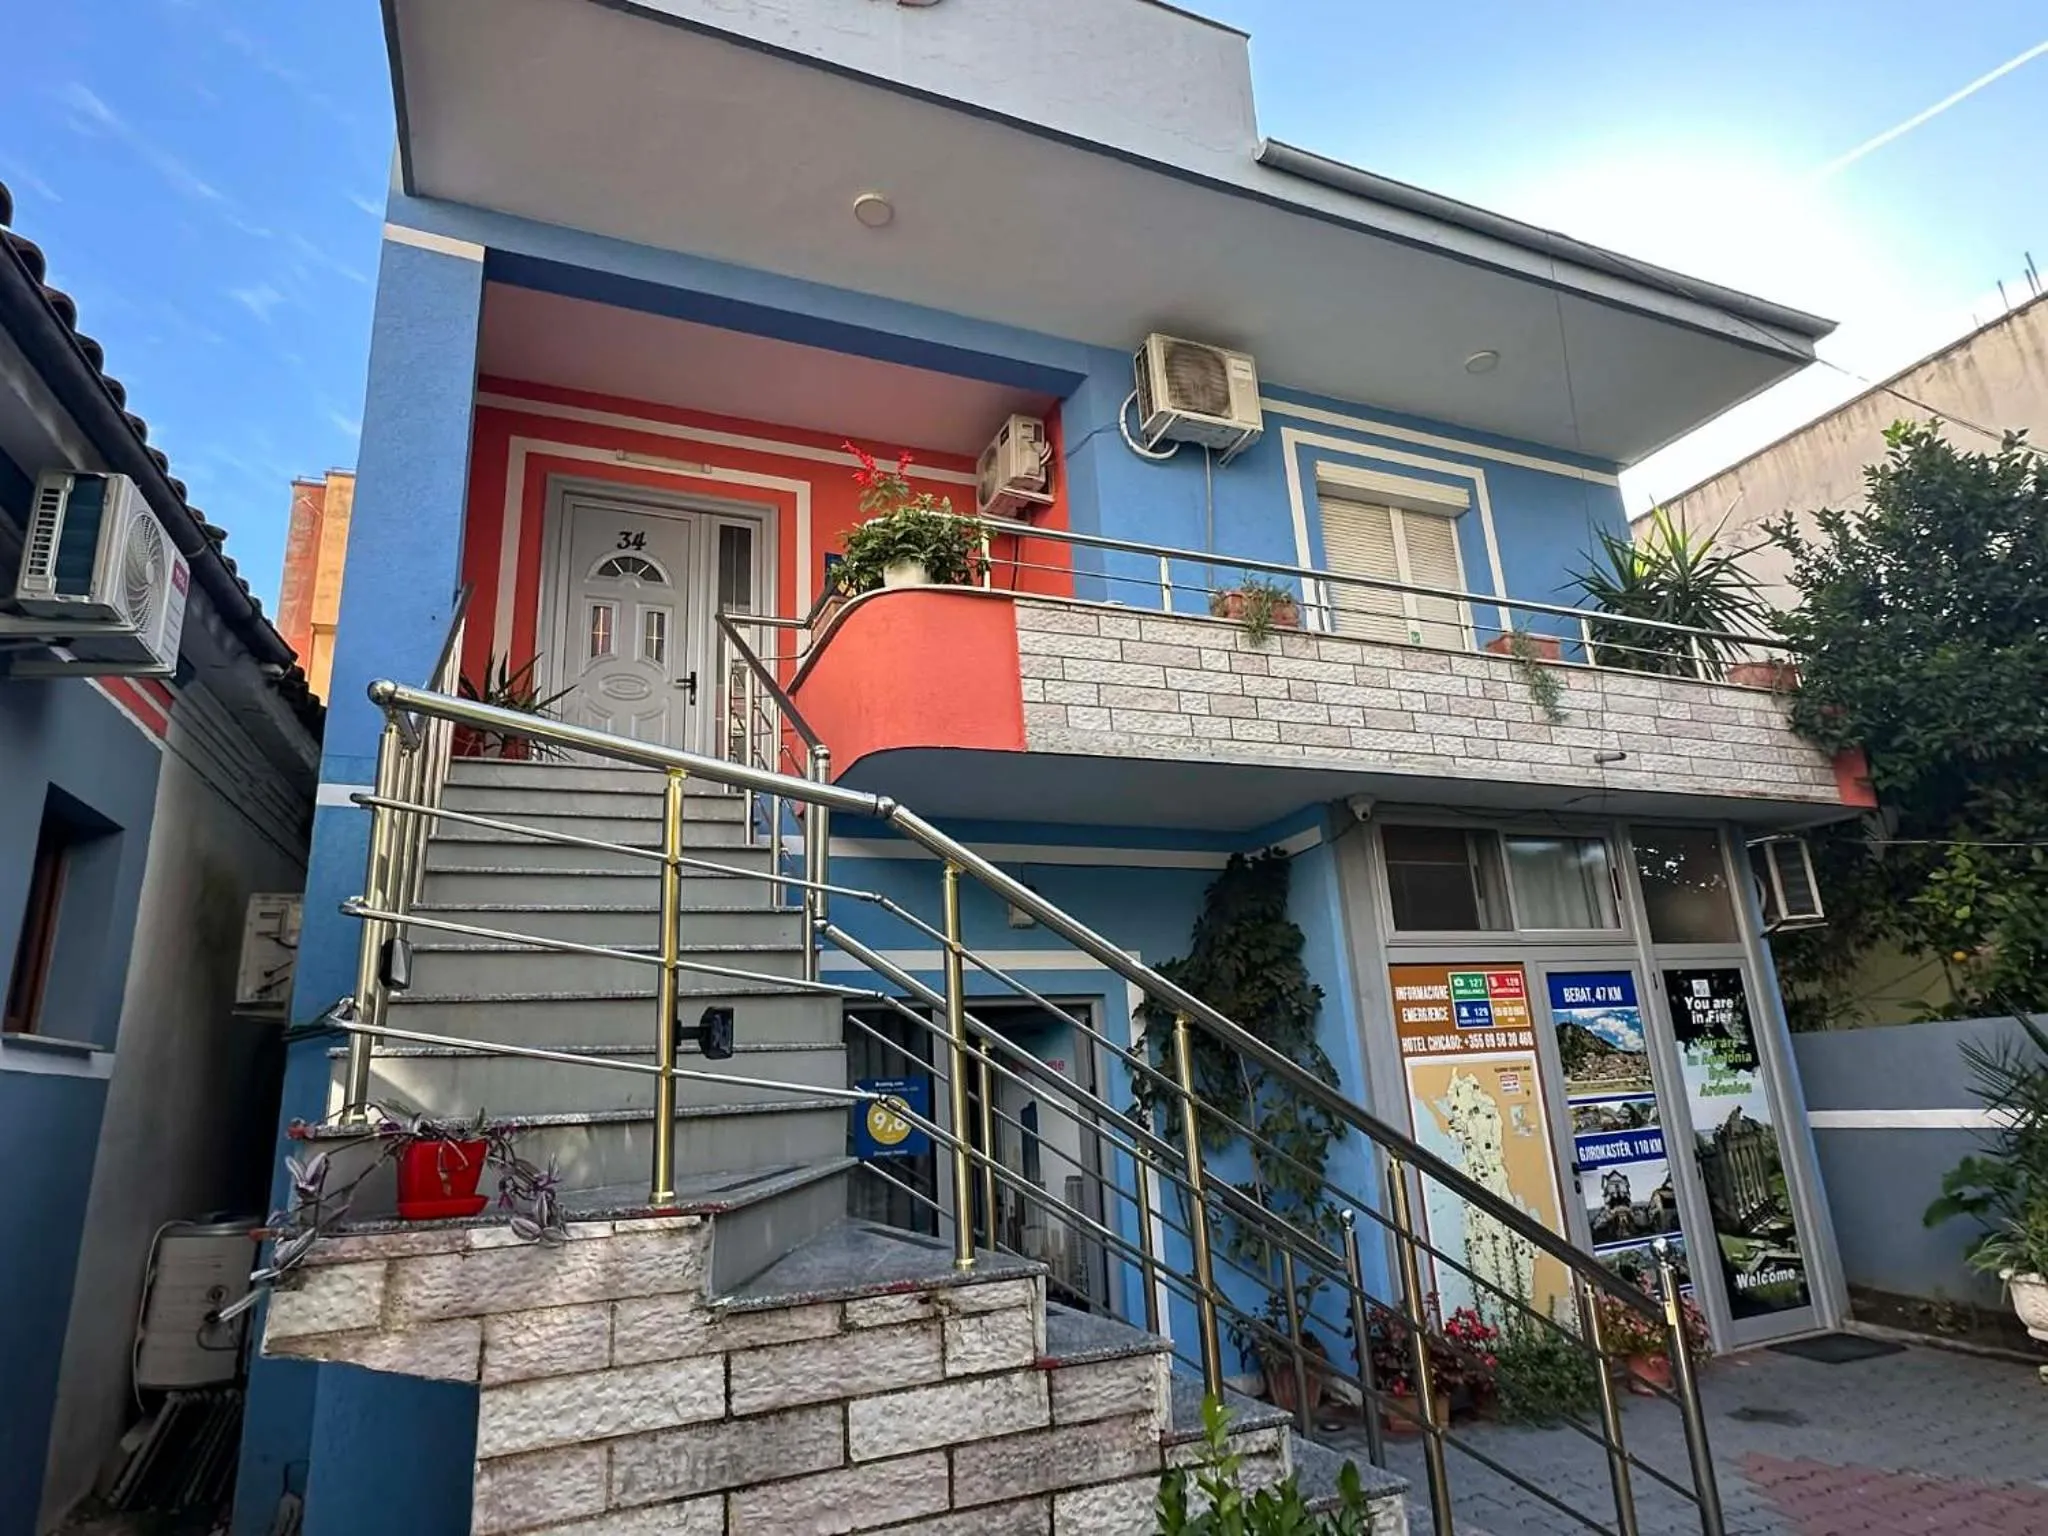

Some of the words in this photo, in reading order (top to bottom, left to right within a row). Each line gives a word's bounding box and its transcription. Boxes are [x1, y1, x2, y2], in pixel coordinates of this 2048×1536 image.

[617, 531, 647, 551] 34
[1469, 979, 1483, 988] 127
[1563, 986, 1595, 1003] BERAT,
[1595, 986, 1606, 1001] 47
[1607, 986, 1623, 1001] KM
[1684, 997, 1710, 1010] You
[1713, 998, 1733, 1009] are
[1691, 1011, 1704, 1024] in
[1707, 1010, 1732, 1023] Fier
[1402, 1036, 1427, 1052] HOTEL
[1427, 1034, 1463, 1051] CHICAGO:
[1694, 1038, 1717, 1050] You
[1720, 1037, 1739, 1048] are
[1634, 1140, 1649, 1155] 110
[1649, 1138, 1663, 1153] KM
[1736, 1268, 1796, 1289] Welcome
